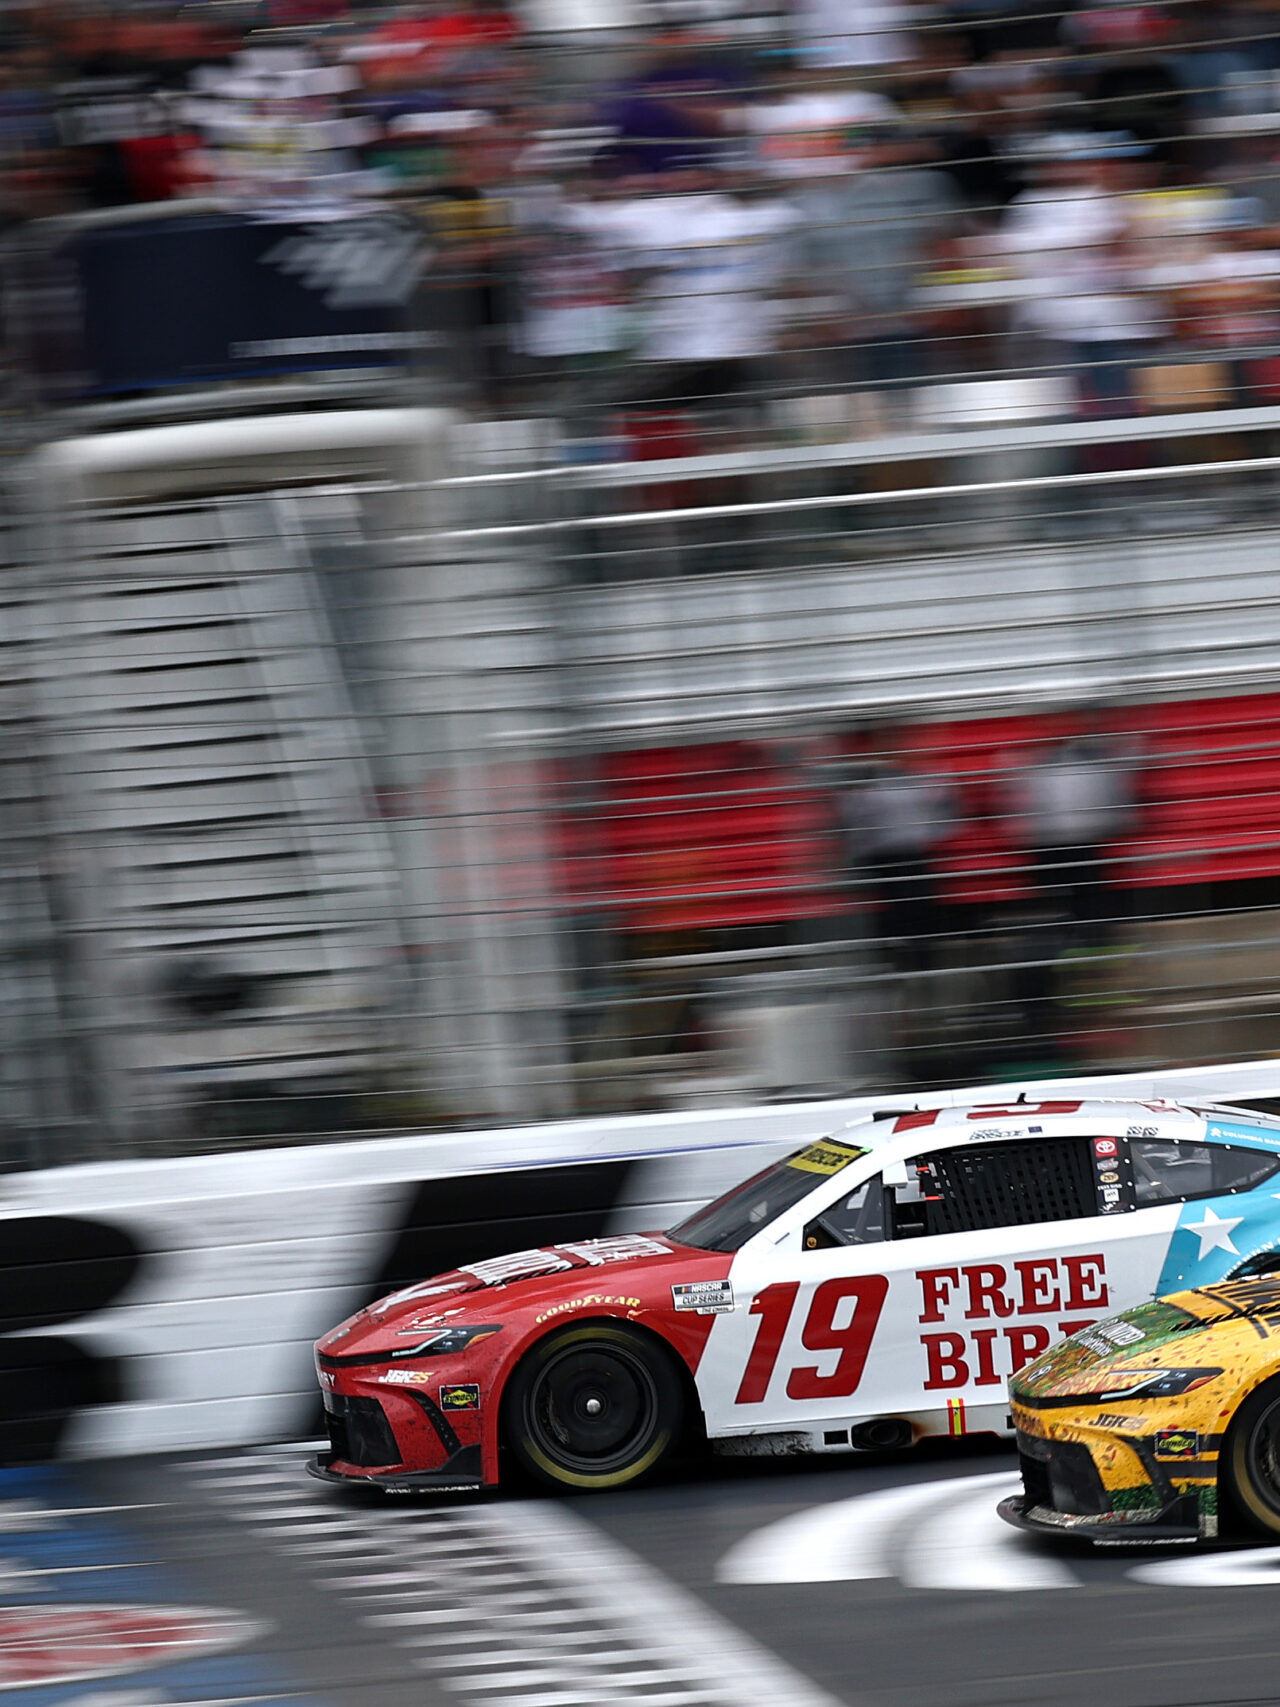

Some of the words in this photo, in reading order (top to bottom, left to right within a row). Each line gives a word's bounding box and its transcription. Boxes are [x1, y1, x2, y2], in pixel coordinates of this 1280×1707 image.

[691, 1283, 722, 1293] NASCAR
[915, 1253, 1109, 1324] FREE
[535, 1294, 641, 1323] GOODYEAR
[682, 1295, 698, 1304] CUP
[699, 1293, 725, 1303] SERIES
[734, 1274, 889, 1405] 19
[1159, 1437, 1196, 1448] SUNOCO
